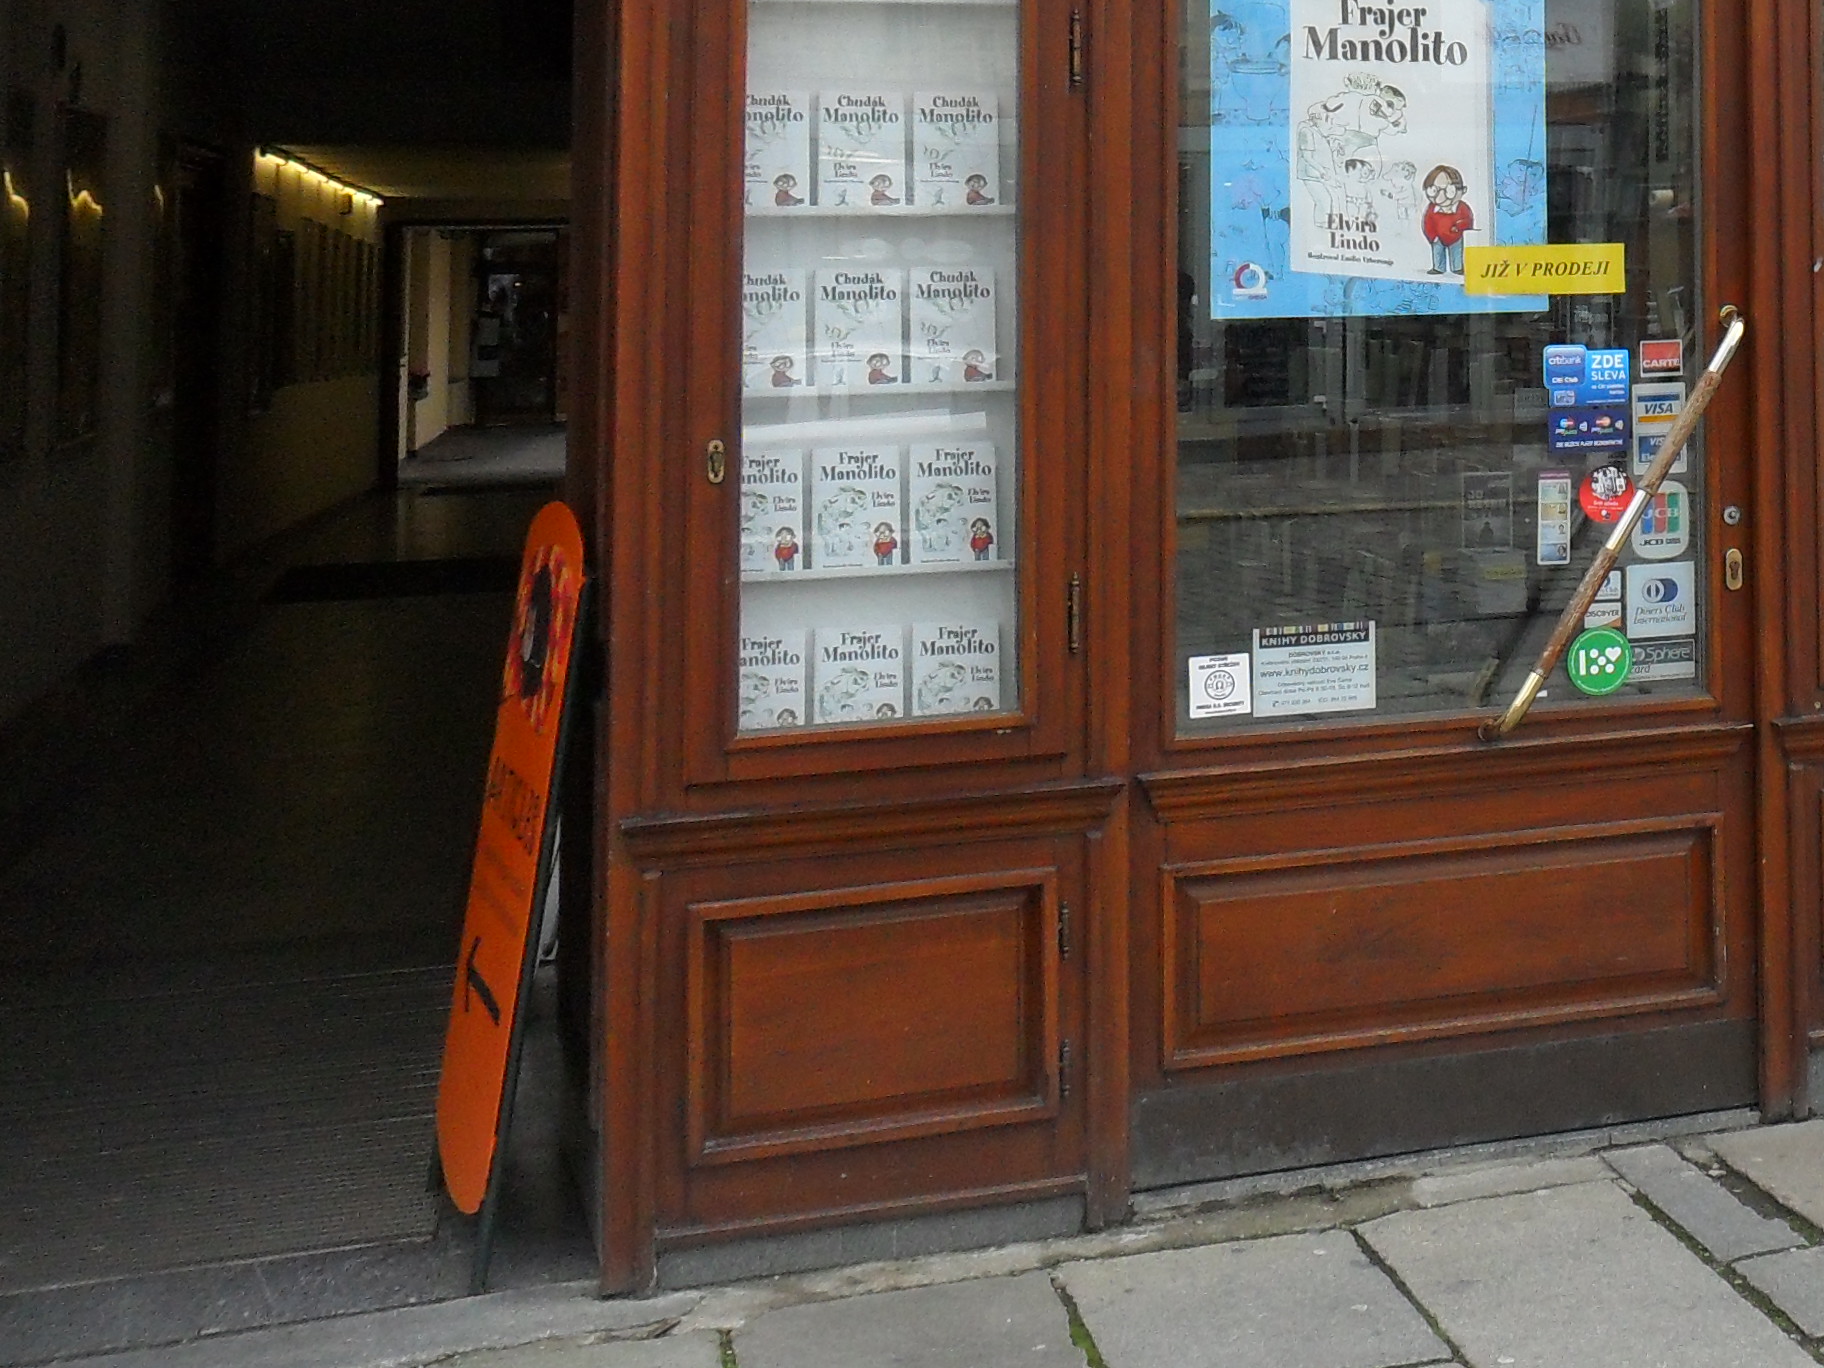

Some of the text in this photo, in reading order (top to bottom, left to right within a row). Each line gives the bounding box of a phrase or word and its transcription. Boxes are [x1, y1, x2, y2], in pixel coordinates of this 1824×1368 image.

[1302, 25, 1468, 66] Manolito
[837, 94, 886, 108] Chudák
[933, 95, 979, 108] Chudák
[823, 107, 899, 124] Manolito
[919, 107, 993, 124] Manolito
[1326, 213, 1377, 233] Elvira
[1330, 231, 1380, 252] Lindo
[929, 270, 977, 283] Chudák
[1481, 260, 1611, 279] JIŽ V PRODEJI
[834, 272, 884, 285] Chudák
[821, 285, 897, 302] Manolito
[916, 282, 990, 299] Manolito
[1591, 354, 1624, 369] ZDE
[1591, 370, 1626, 381] SLEVA
[1644, 402, 1674, 415] VISA
[839, 451, 879, 469] Frajer
[935, 447, 975, 466] Frajer
[820, 464, 896, 482] Manolito
[917, 460, 992, 478] Manolito
[840, 631, 882, 650] Frajer
[938, 625, 978, 645] Frajer
[1261, 635, 1297, 646] KNIHY
[822, 644, 899, 663] Manolito
[919, 638, 995, 657] Manolito
[1646, 646, 1690, 662] Sphere
